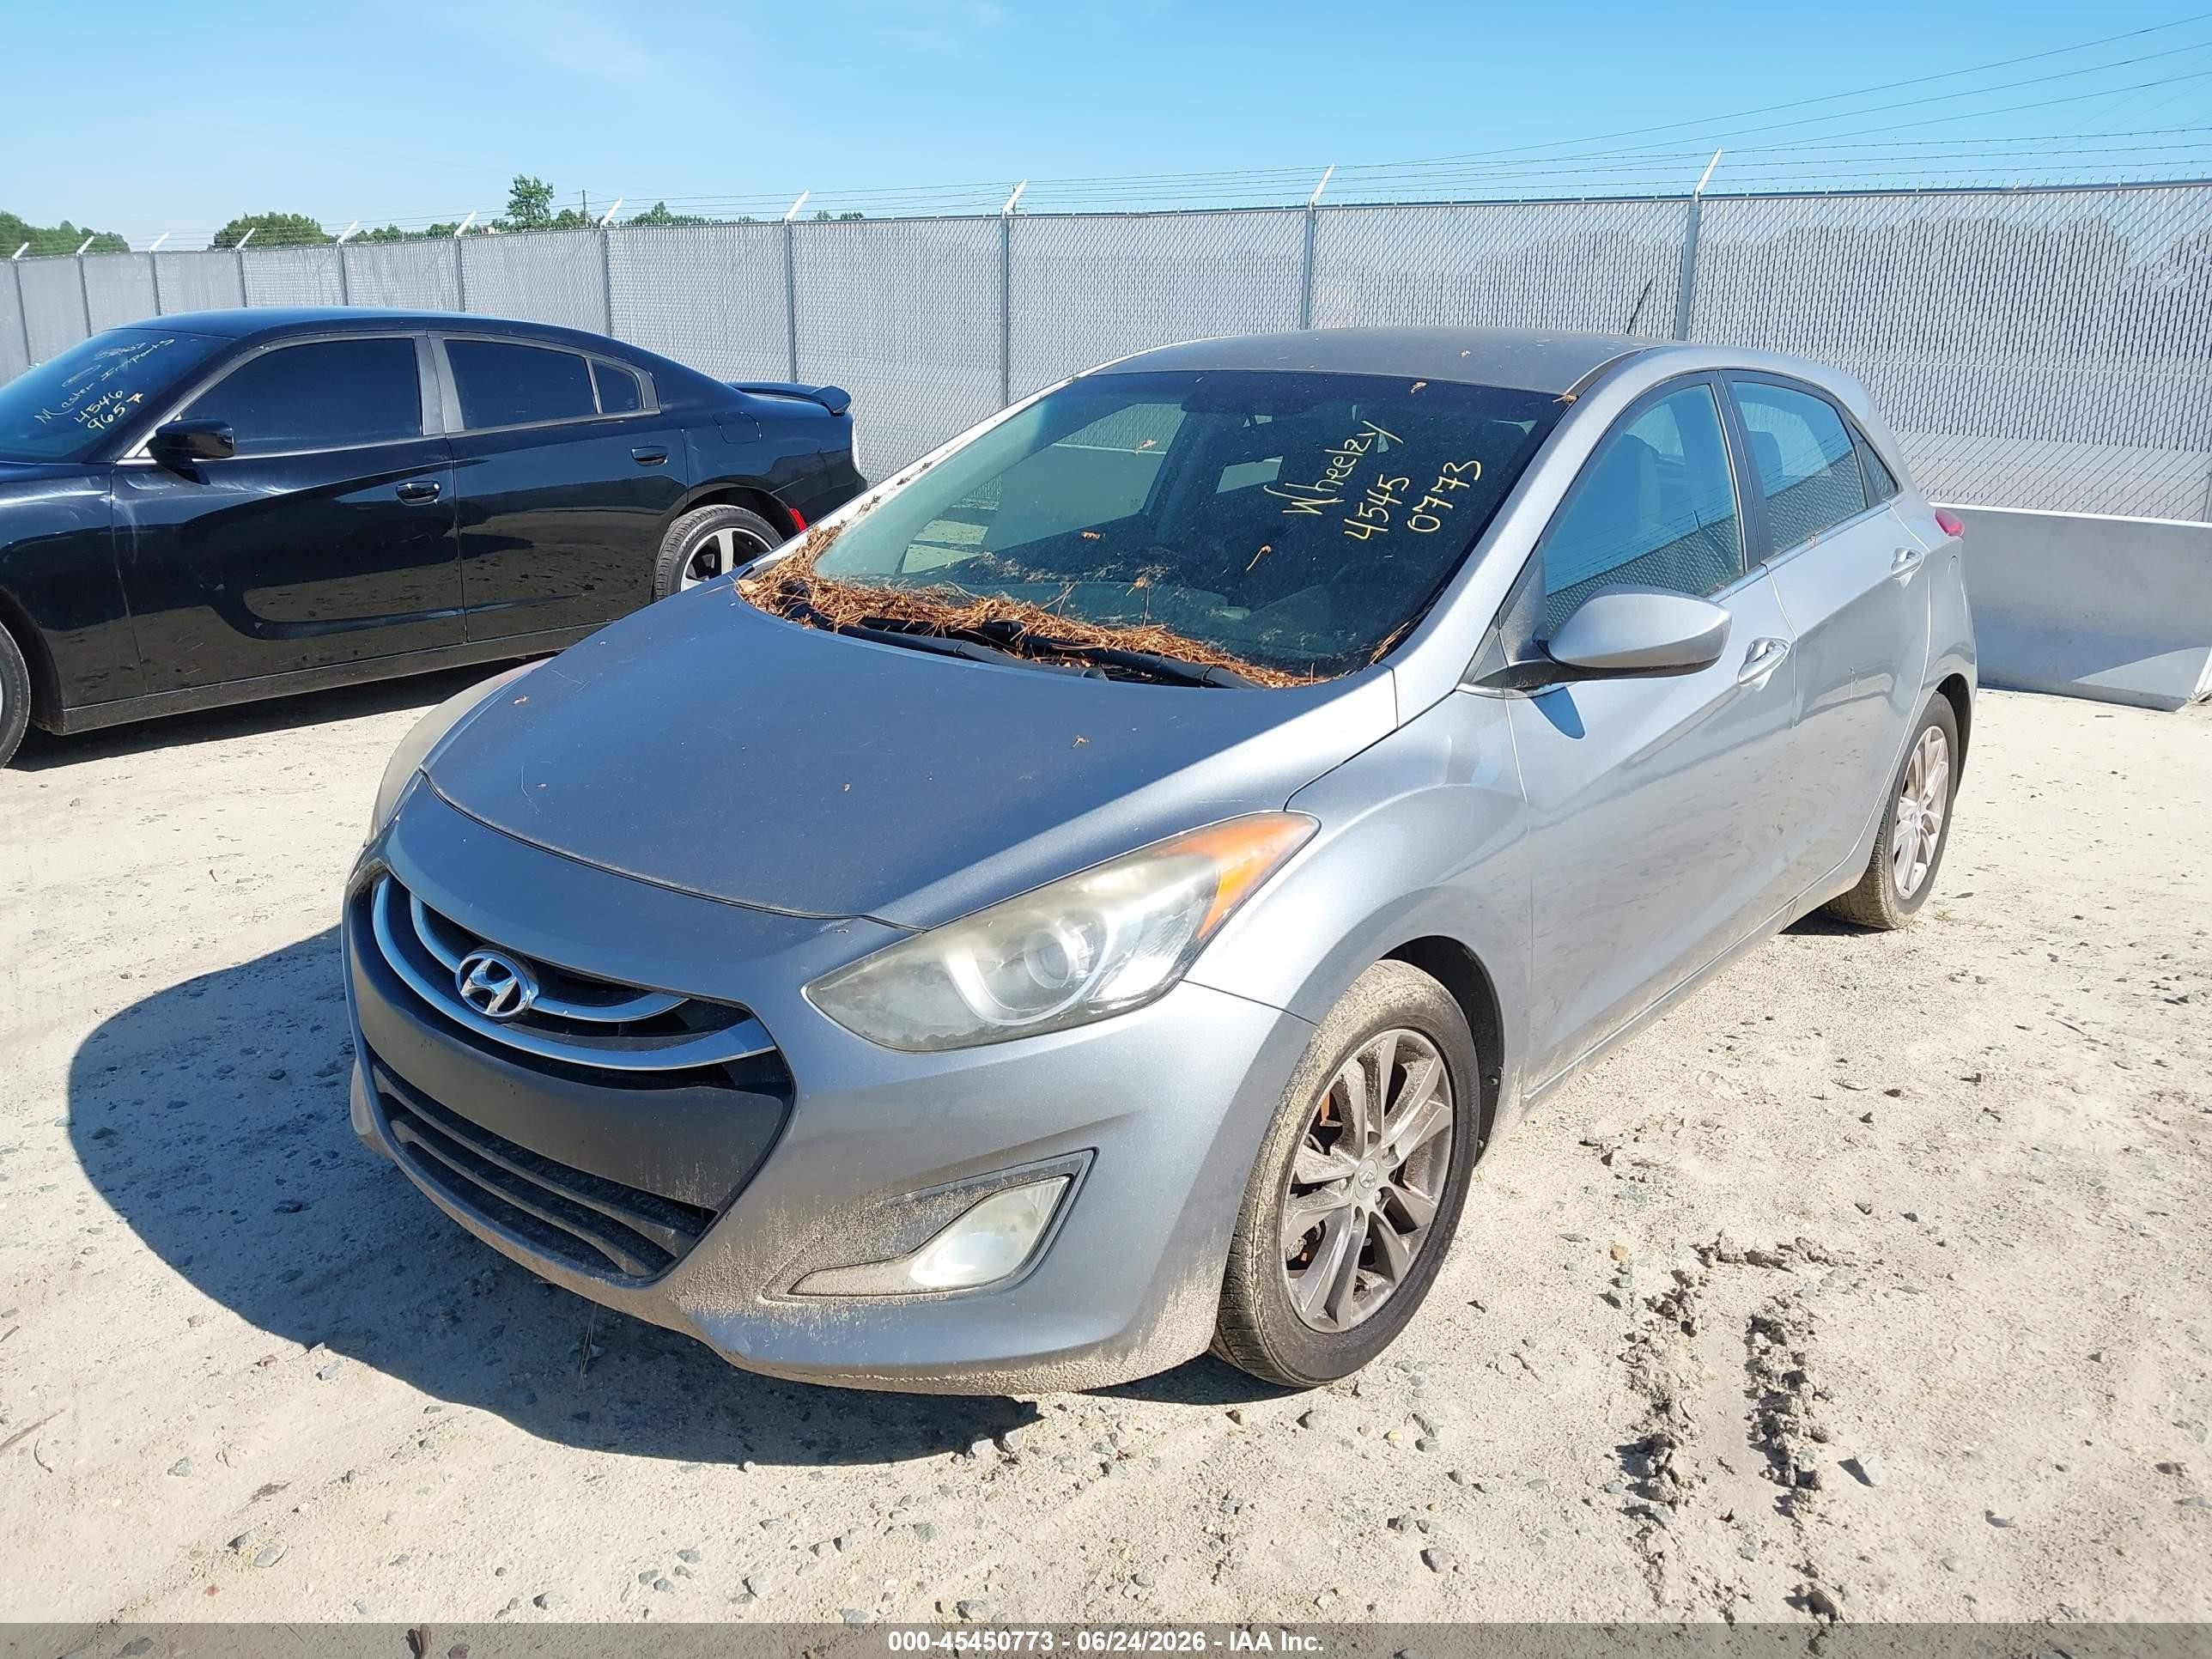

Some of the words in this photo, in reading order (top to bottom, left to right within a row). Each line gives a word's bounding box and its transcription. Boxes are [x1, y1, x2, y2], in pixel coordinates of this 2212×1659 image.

[74, 390, 124, 423] 4546
[1263, 420, 1404, 515] Wheelzy
[1407, 460, 1482, 532] 0773
[1343, 474, 1410, 540] 4545
